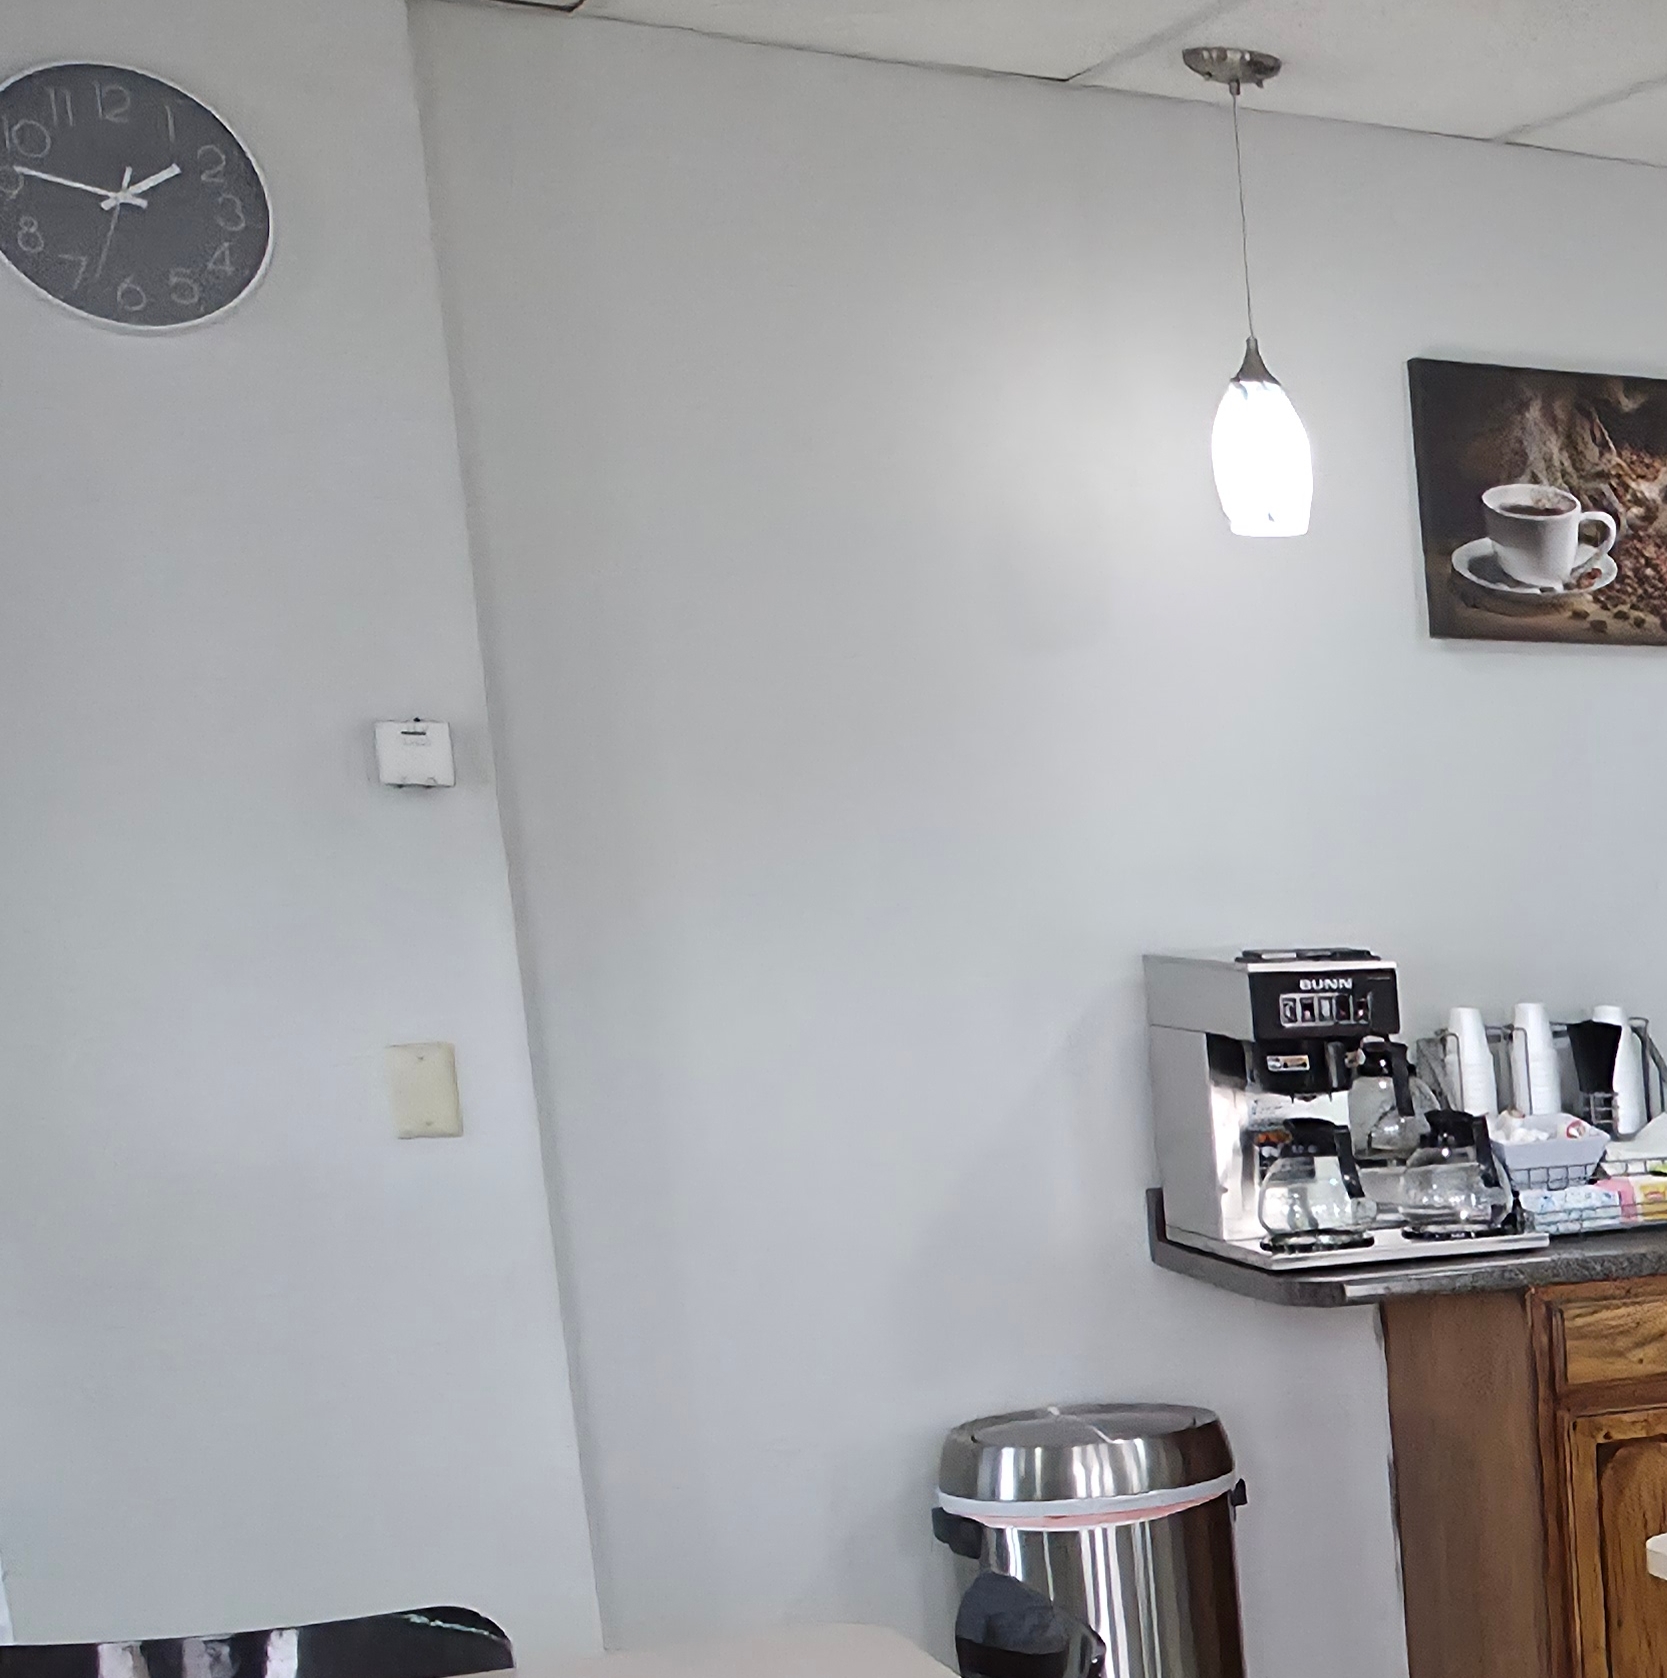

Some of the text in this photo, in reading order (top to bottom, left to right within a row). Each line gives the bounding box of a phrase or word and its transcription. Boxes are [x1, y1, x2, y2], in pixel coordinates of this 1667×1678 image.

[46, 85, 74, 127] 11
[94, 82, 130, 123] 12
[1, 114, 50, 158] 10
[163, 104, 175, 142] 1
[197, 144, 226, 182] 2
[215, 194, 246, 231] 3
[17, 215, 44, 252] 8
[58, 253, 88, 290] 7
[206, 241, 234, 275] 4
[116, 275, 147, 311] 6
[168, 267, 200, 304] 5
[1299, 978, 1353, 992] BUNN
